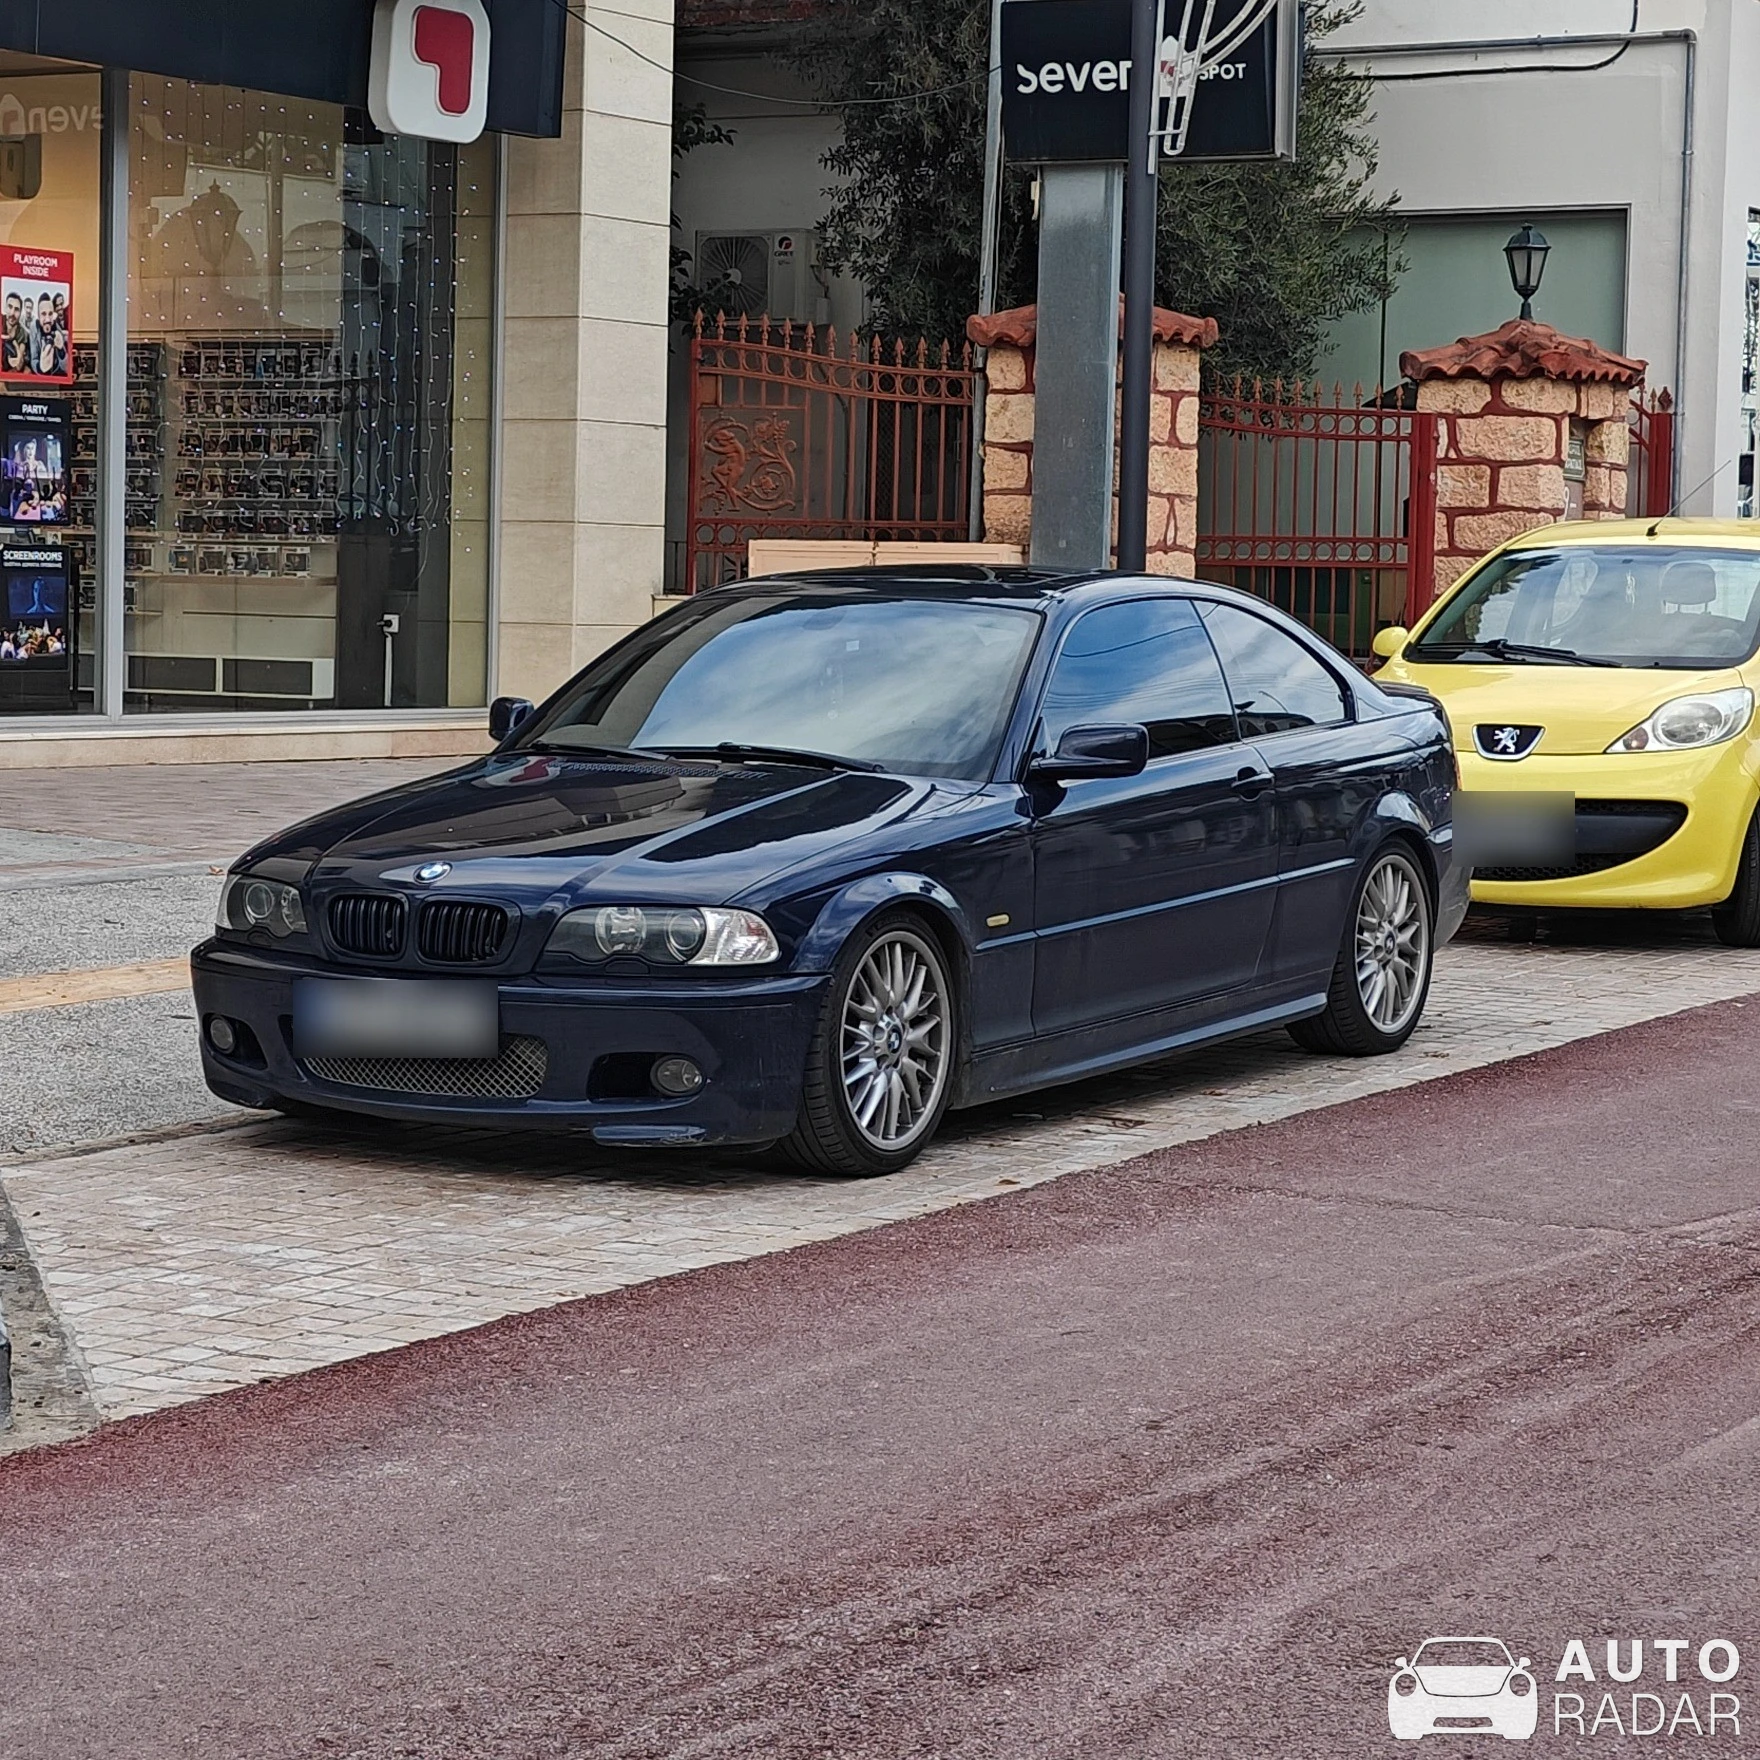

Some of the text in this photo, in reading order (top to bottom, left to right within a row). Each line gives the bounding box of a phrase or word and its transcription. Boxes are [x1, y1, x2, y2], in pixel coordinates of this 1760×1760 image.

[1199, 63, 1247, 80] SPOT
[13, 253, 58, 268] PLAYROOM
[22, 265, 49, 277] INSIDE
[21, 403, 48, 415] PARTY
[3, 550, 63, 561] SCREENROOMS
